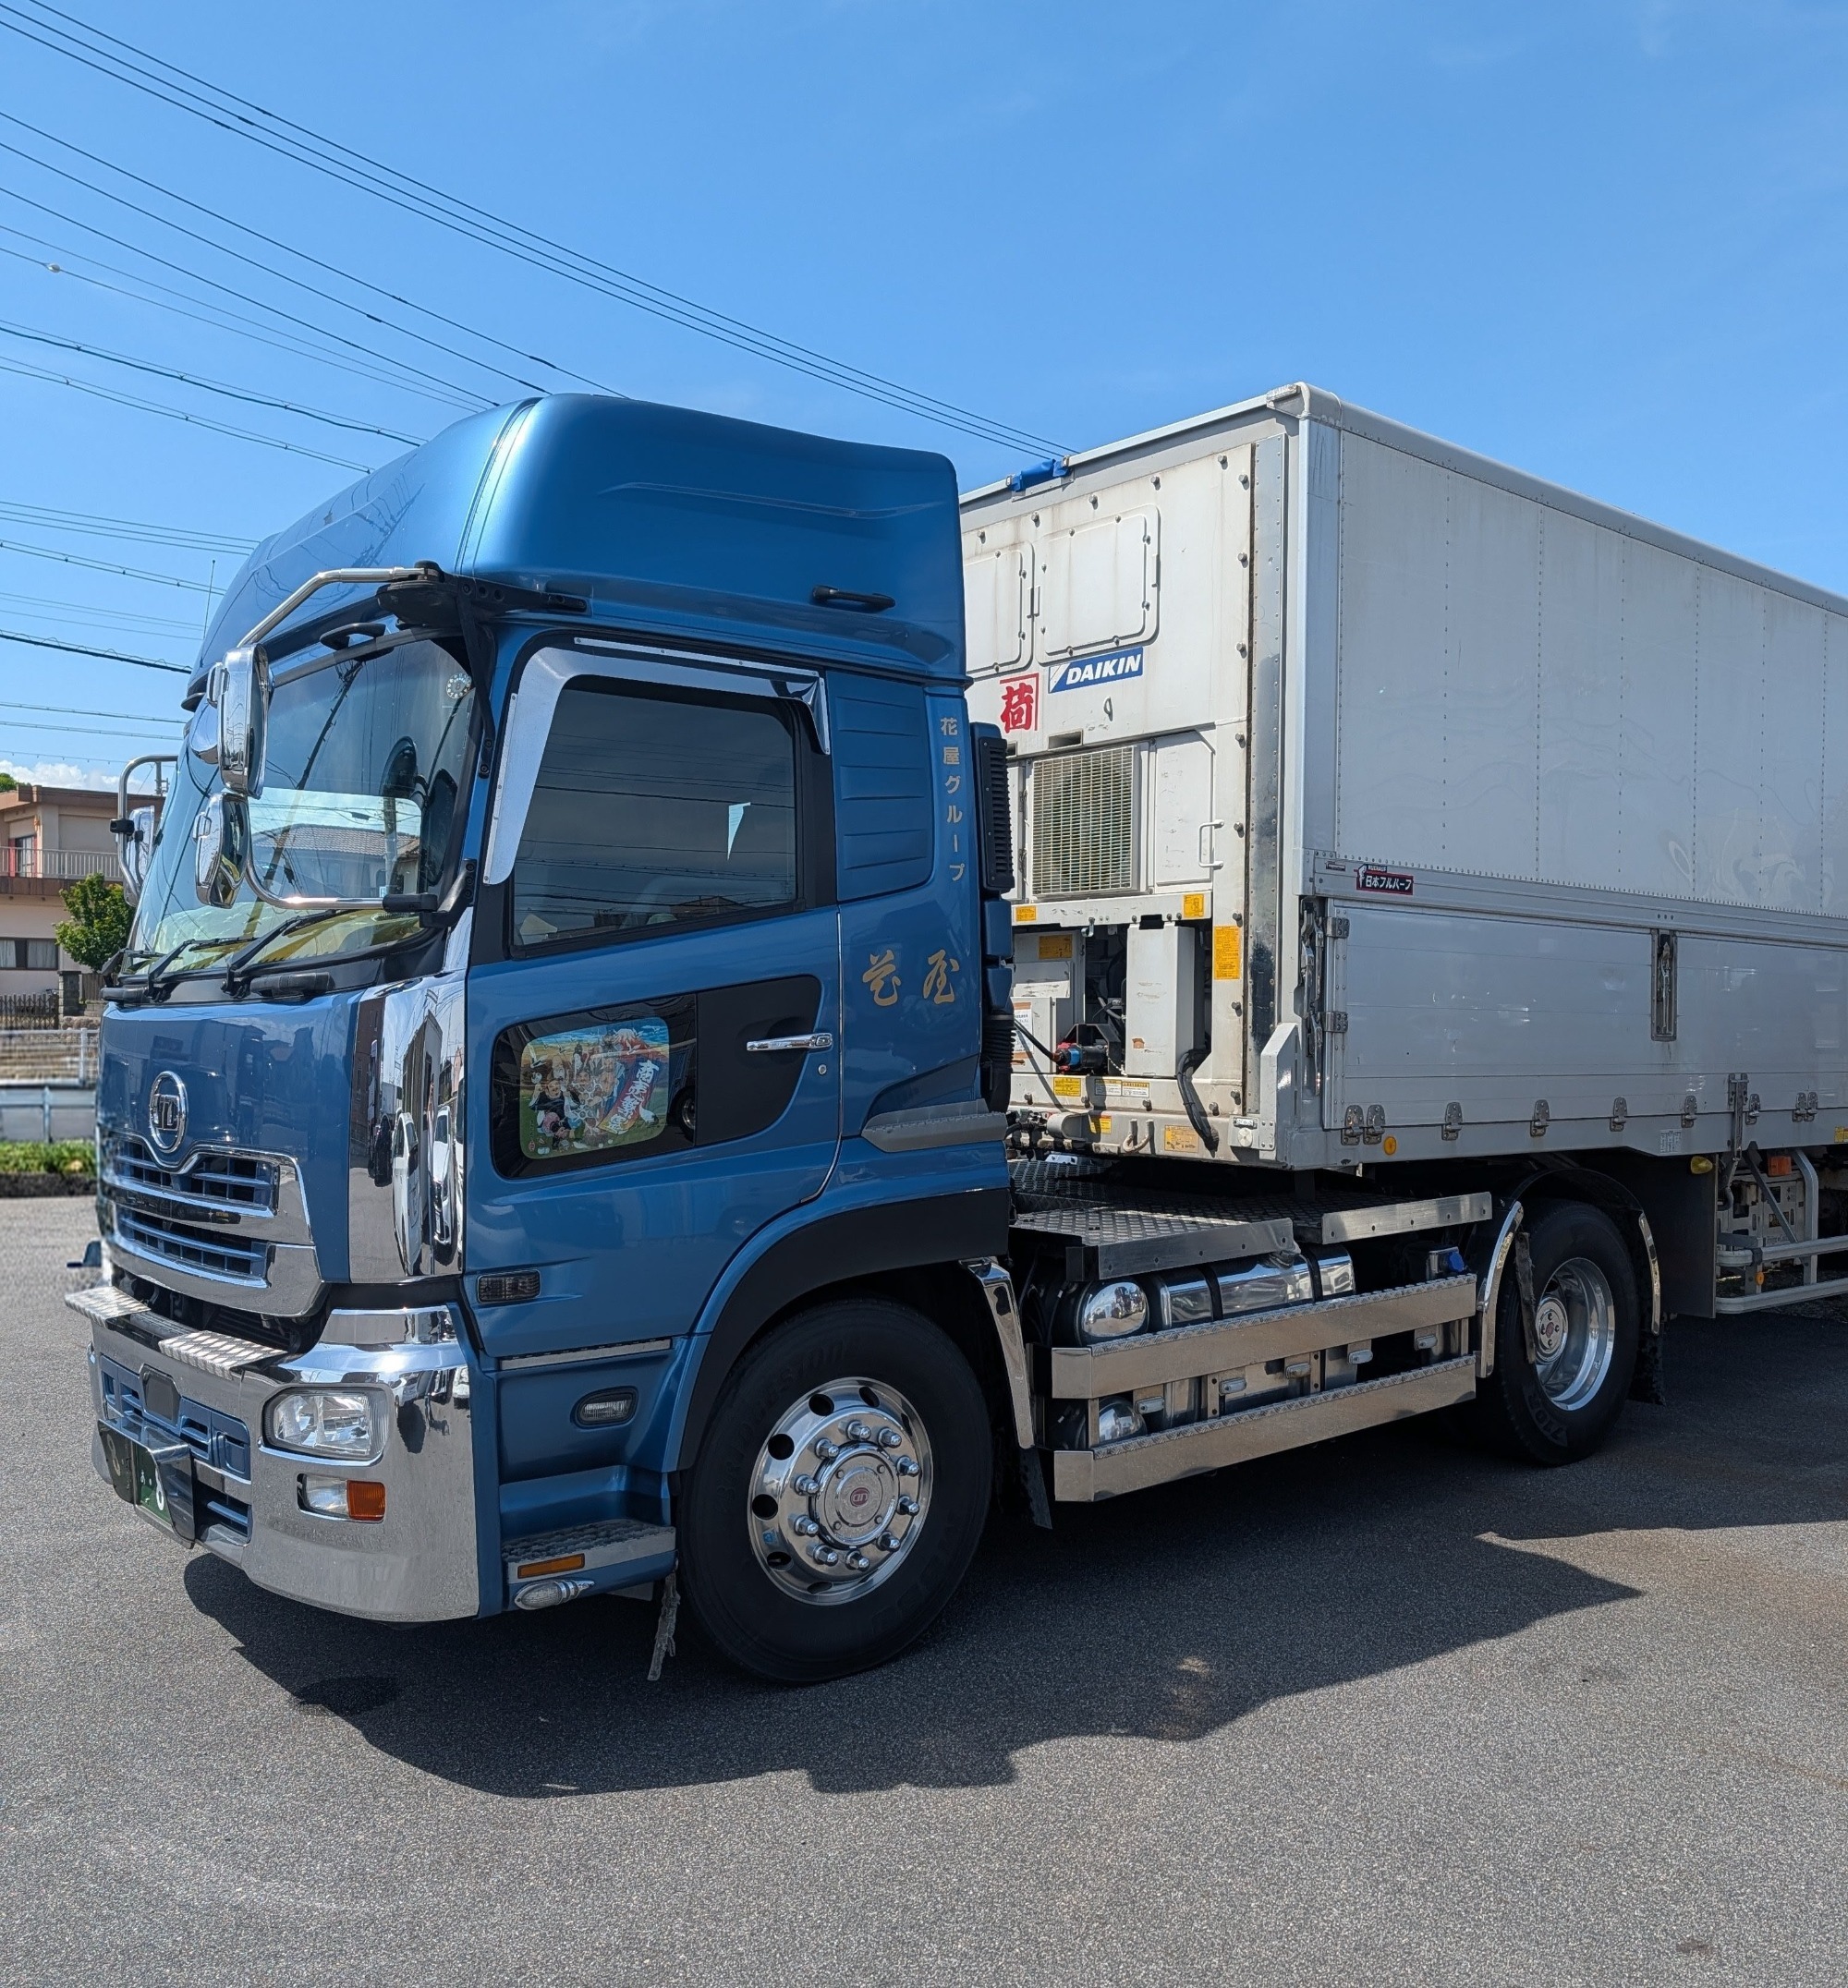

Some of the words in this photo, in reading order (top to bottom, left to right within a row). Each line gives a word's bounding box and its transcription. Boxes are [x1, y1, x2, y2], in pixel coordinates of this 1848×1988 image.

[1064, 653, 1142, 686] DAIKIN
[1000, 682, 1034, 733] 荷
[940, 716, 967, 882] 花屋グループ
[1366, 875, 1412, 891] 日本フルハーフ
